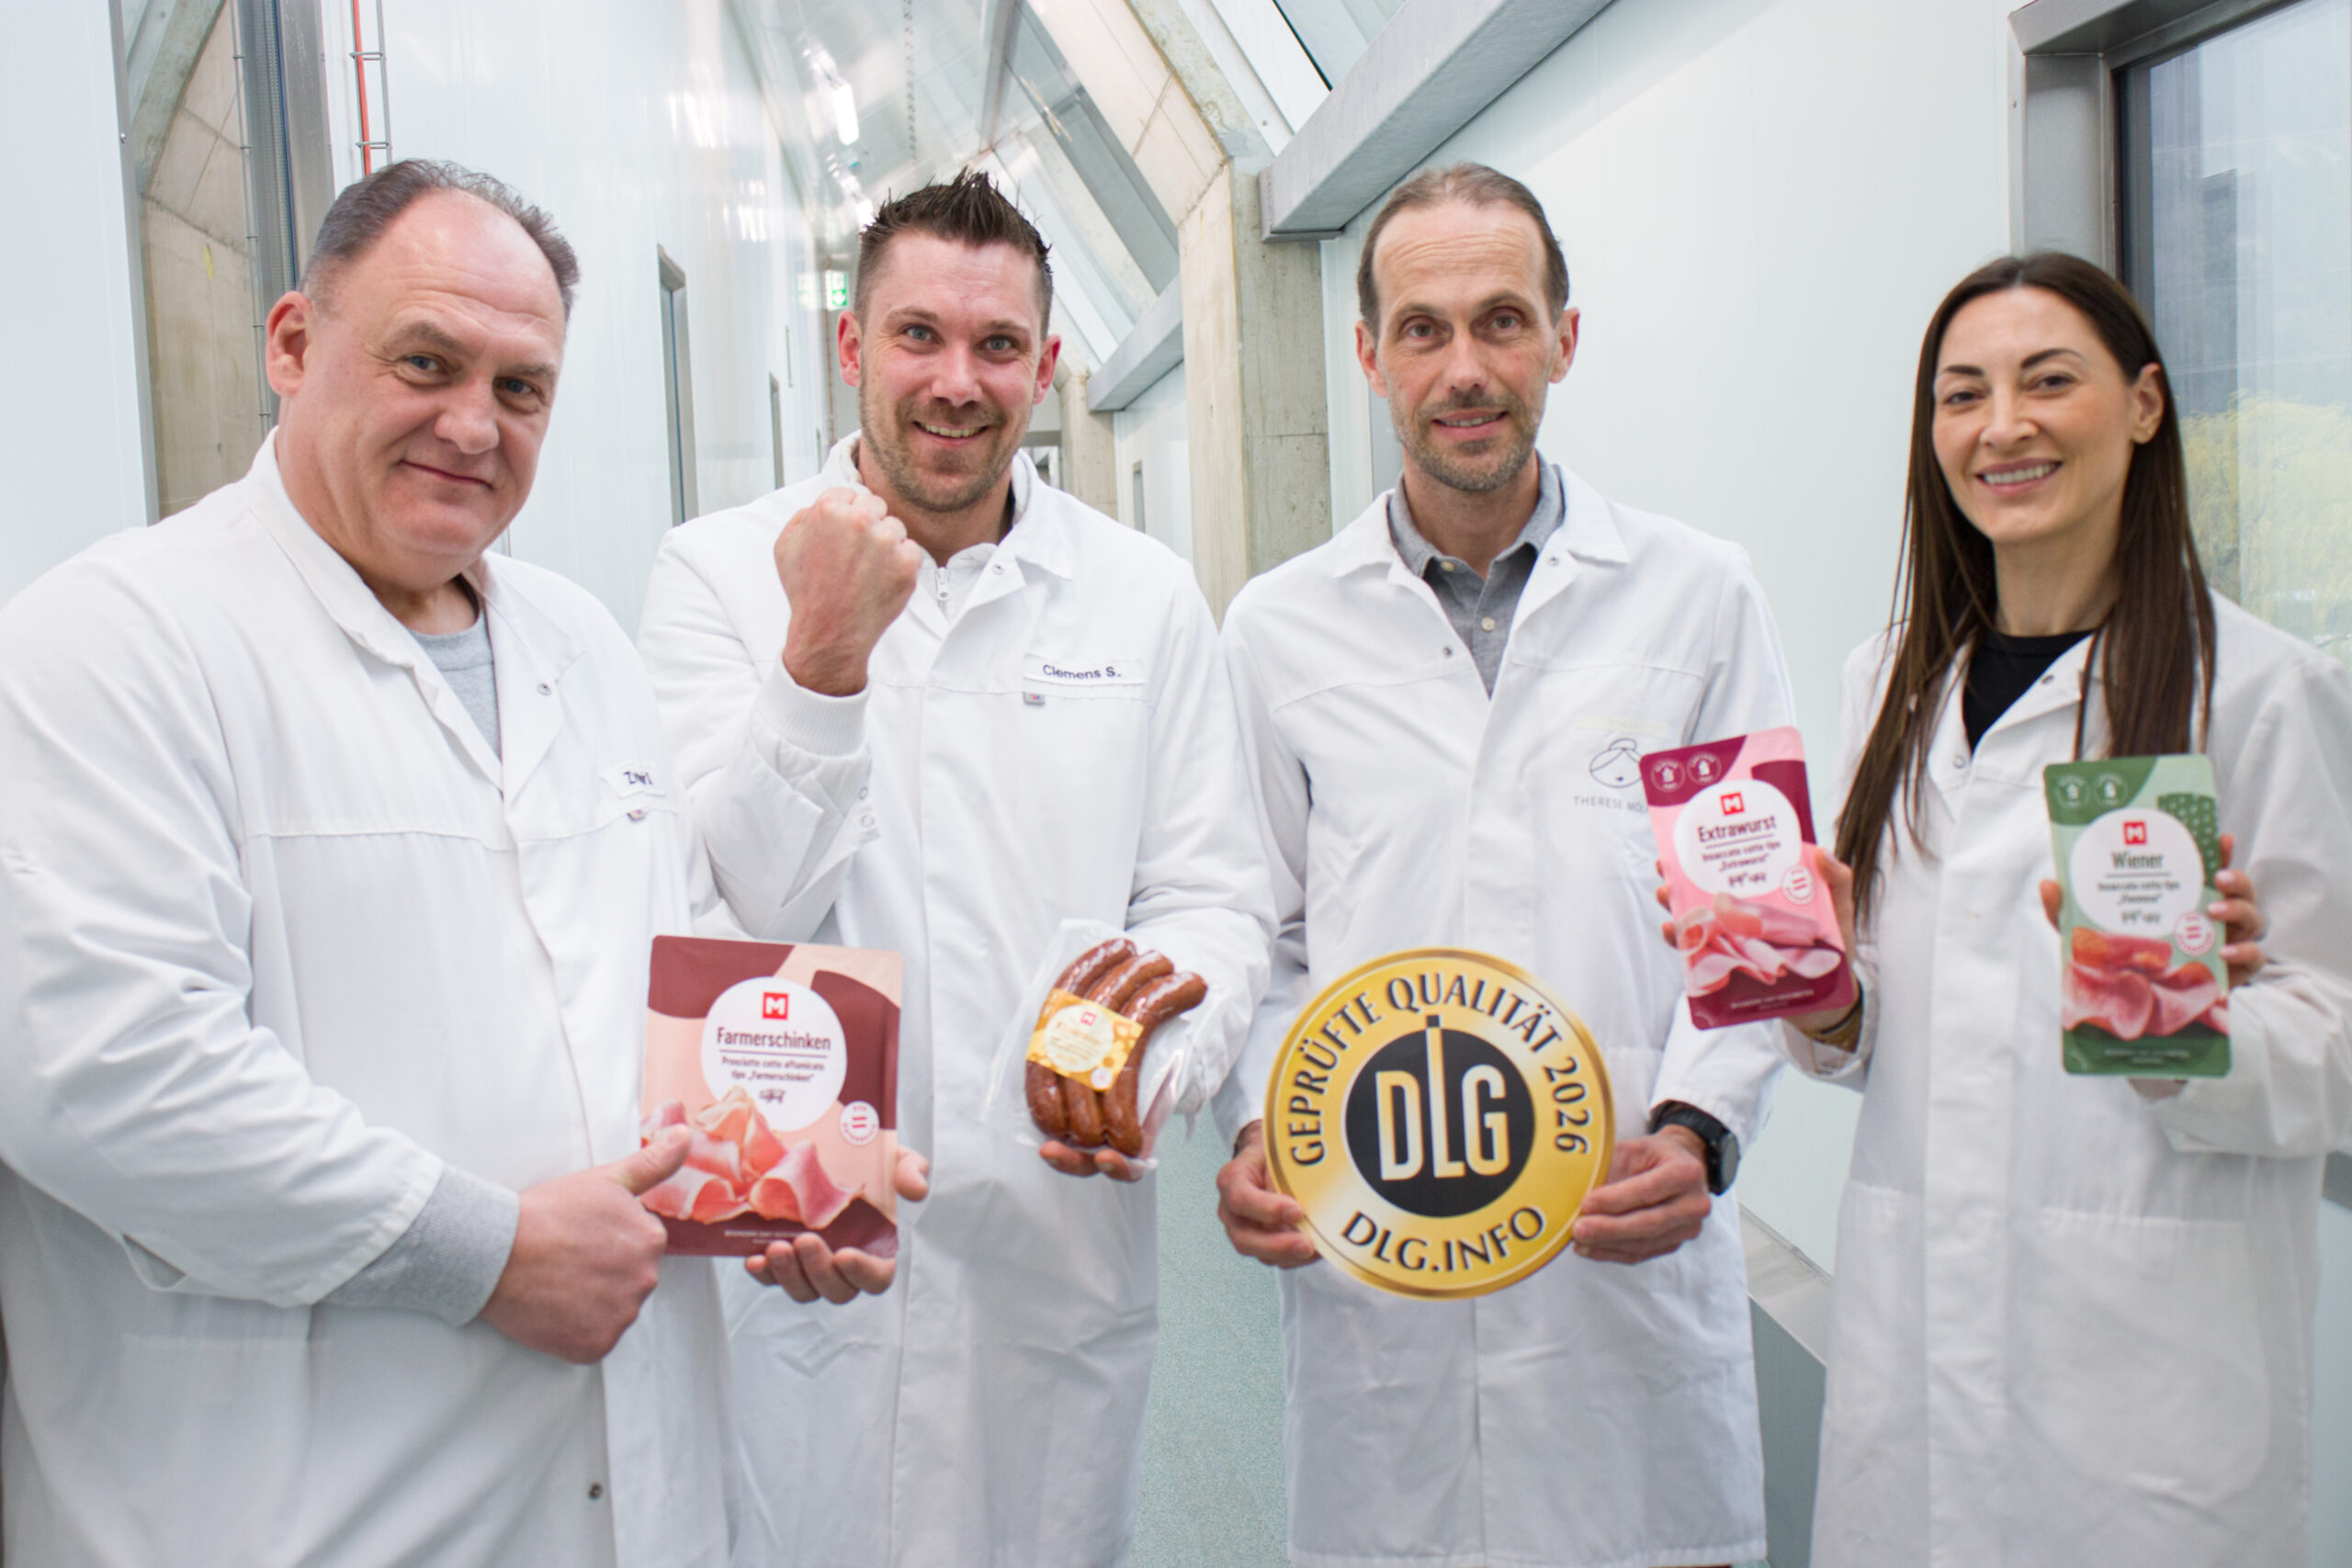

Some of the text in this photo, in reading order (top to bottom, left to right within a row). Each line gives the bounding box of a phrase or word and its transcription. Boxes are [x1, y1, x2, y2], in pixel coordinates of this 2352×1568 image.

[1043, 664, 1122, 680] Clemens S.
[1573, 795, 1623, 809] THERESE
[1698, 816, 1777, 842] Extrawurst
[2110, 851, 2164, 868] Wiener
[763, 995, 787, 1017] M
[717, 1027, 831, 1050] Farmerschinken
[1288, 972, 1592, 1168] GEPRÜFTE QUALITÄT 2026
[1374, 1015, 1510, 1181] DLG
[1340, 1205, 1545, 1272] DLG.INFO
